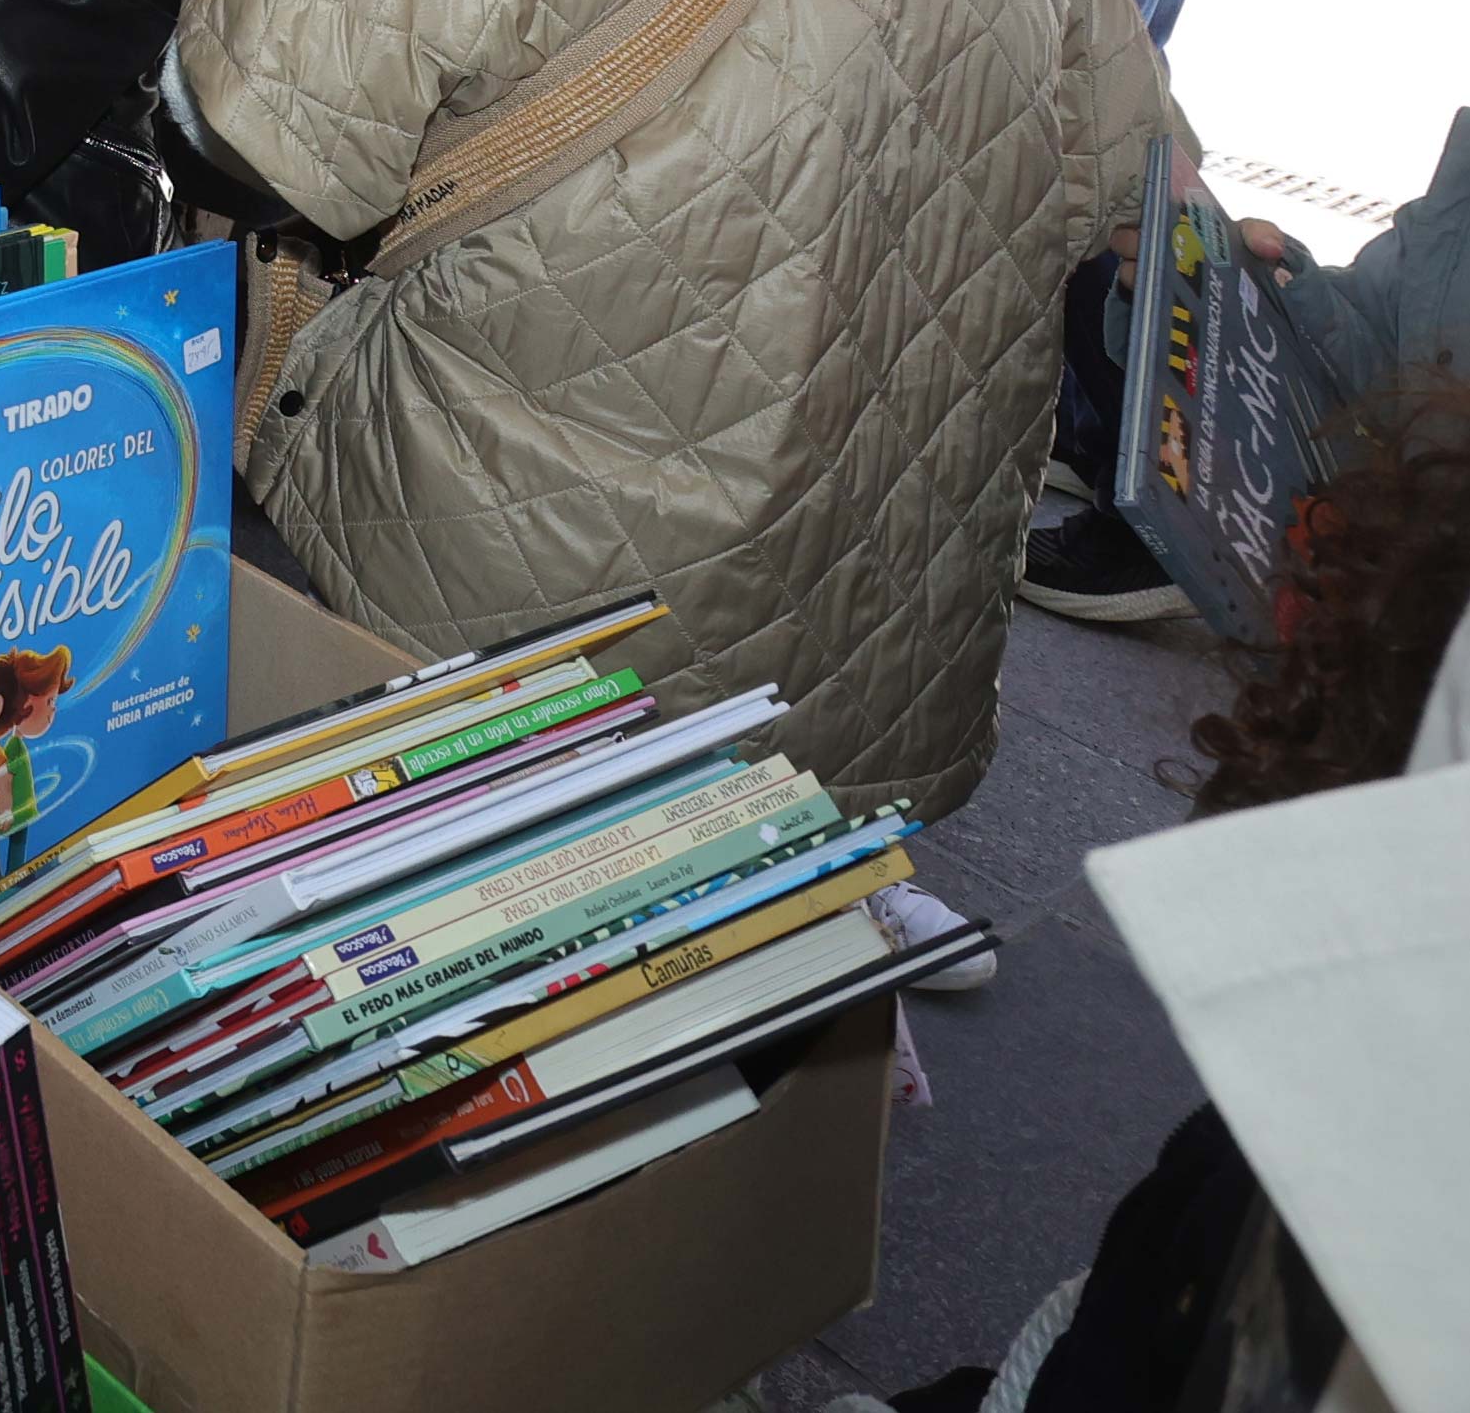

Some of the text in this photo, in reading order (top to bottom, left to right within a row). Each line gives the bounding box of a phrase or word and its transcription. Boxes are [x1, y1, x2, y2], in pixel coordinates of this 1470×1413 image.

[4, 383, 94, 434] TIRADO
[40, 431, 155, 482] COLORES DEL
[112, 675, 190, 712] Ilustraciones de
[534, 686, 591, 717] esconder
[593, 678, 620, 702] Cómo
[106, 688, 195, 732] NÚRIA APARICIO
[408, 737, 451, 773] escuela
[662, 765, 773, 822] SMALLMAN DREIDEMY
[689, 783, 800, 842] SMALLMAN DREIDEMY
[157, 842, 203, 866] Beascoa
[184, 905, 259, 955] BRUNO SALAMONE
[337, 929, 387, 955] Beascoa
[110, 966, 144, 996] ANTOINE
[343, 927, 545, 1025] EL PEDO MÁS GRANDE DEL MUNDO
[361, 951, 409, 976] Beascoa
[641, 943, 714, 987] Camuñas
[56, 991, 96, 1022] demostrar!
[13, 1049, 26, 1073] 8
